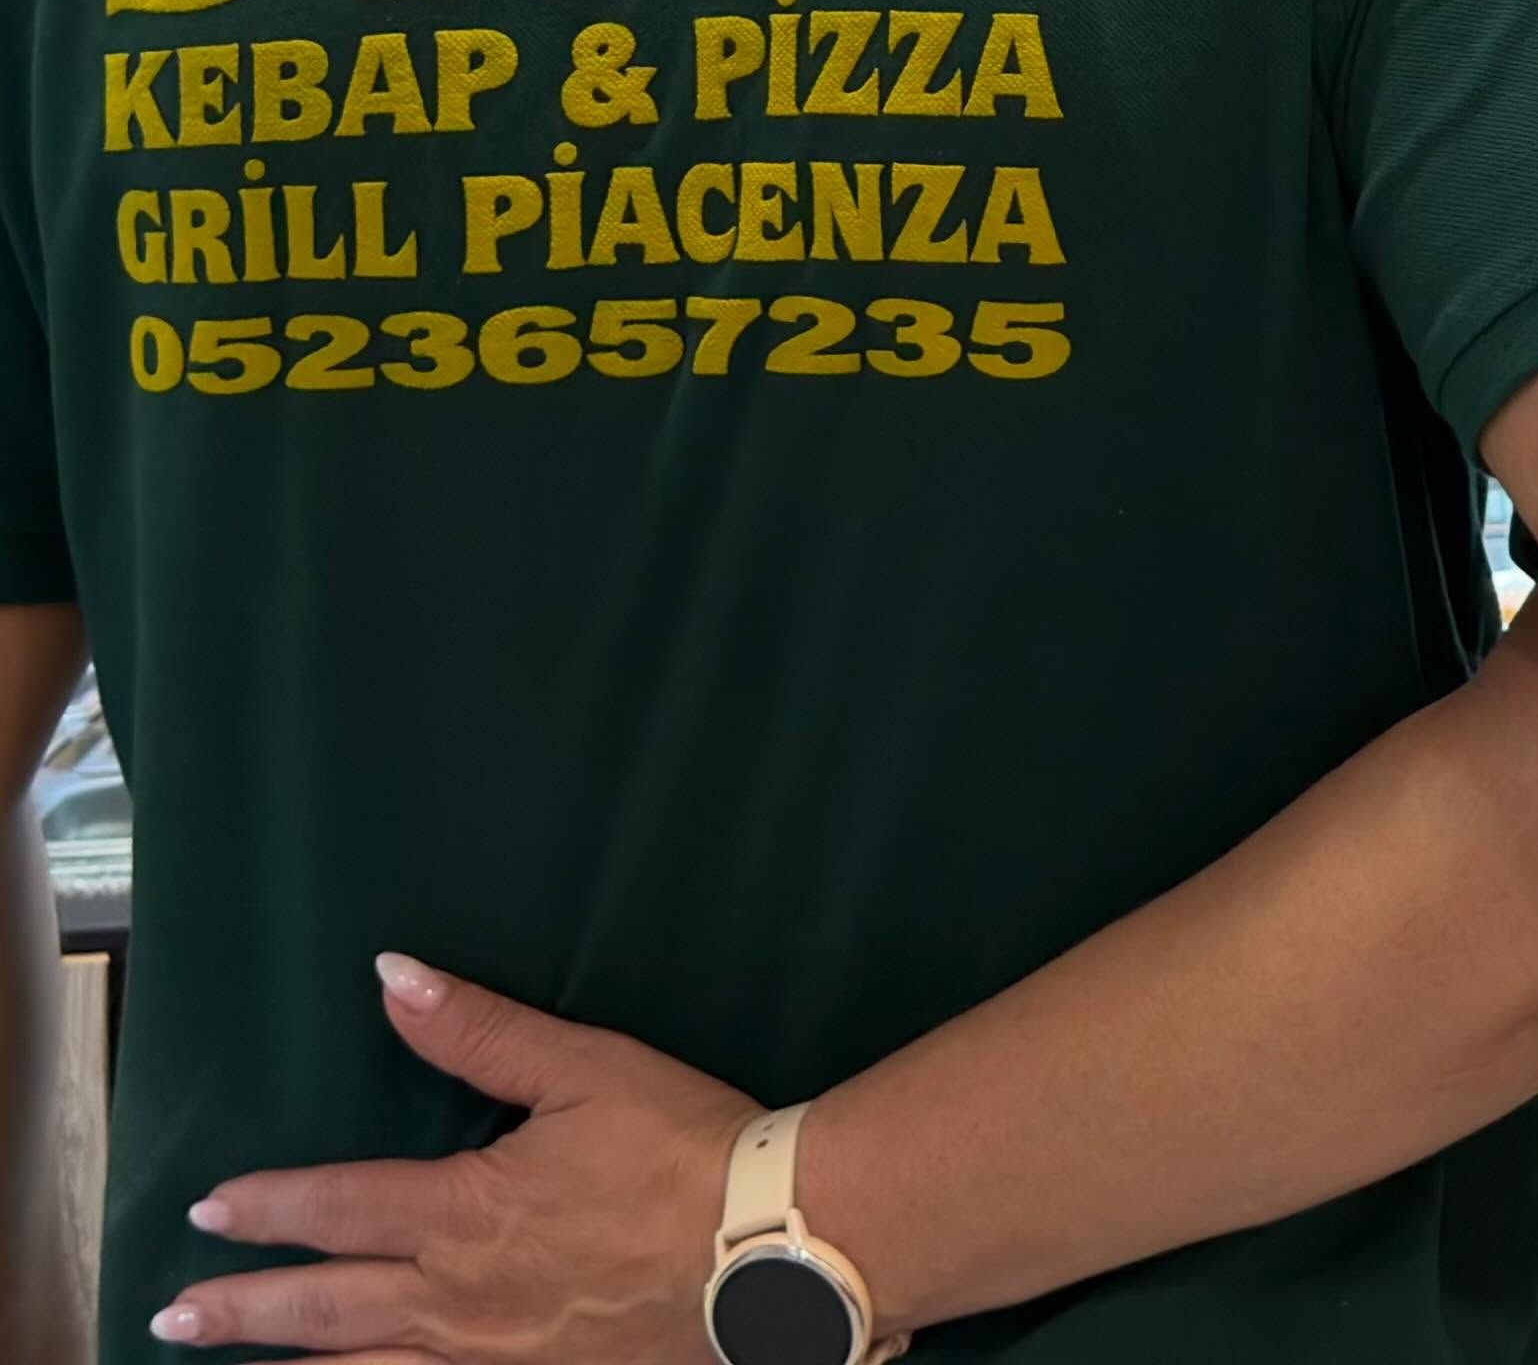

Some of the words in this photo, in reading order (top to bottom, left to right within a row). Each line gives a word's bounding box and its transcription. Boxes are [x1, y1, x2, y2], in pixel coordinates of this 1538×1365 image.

[103, 28, 518, 151] KEBAP
[561, 22, 658, 128] &
[130, 296, 1071, 394] 0523657235
